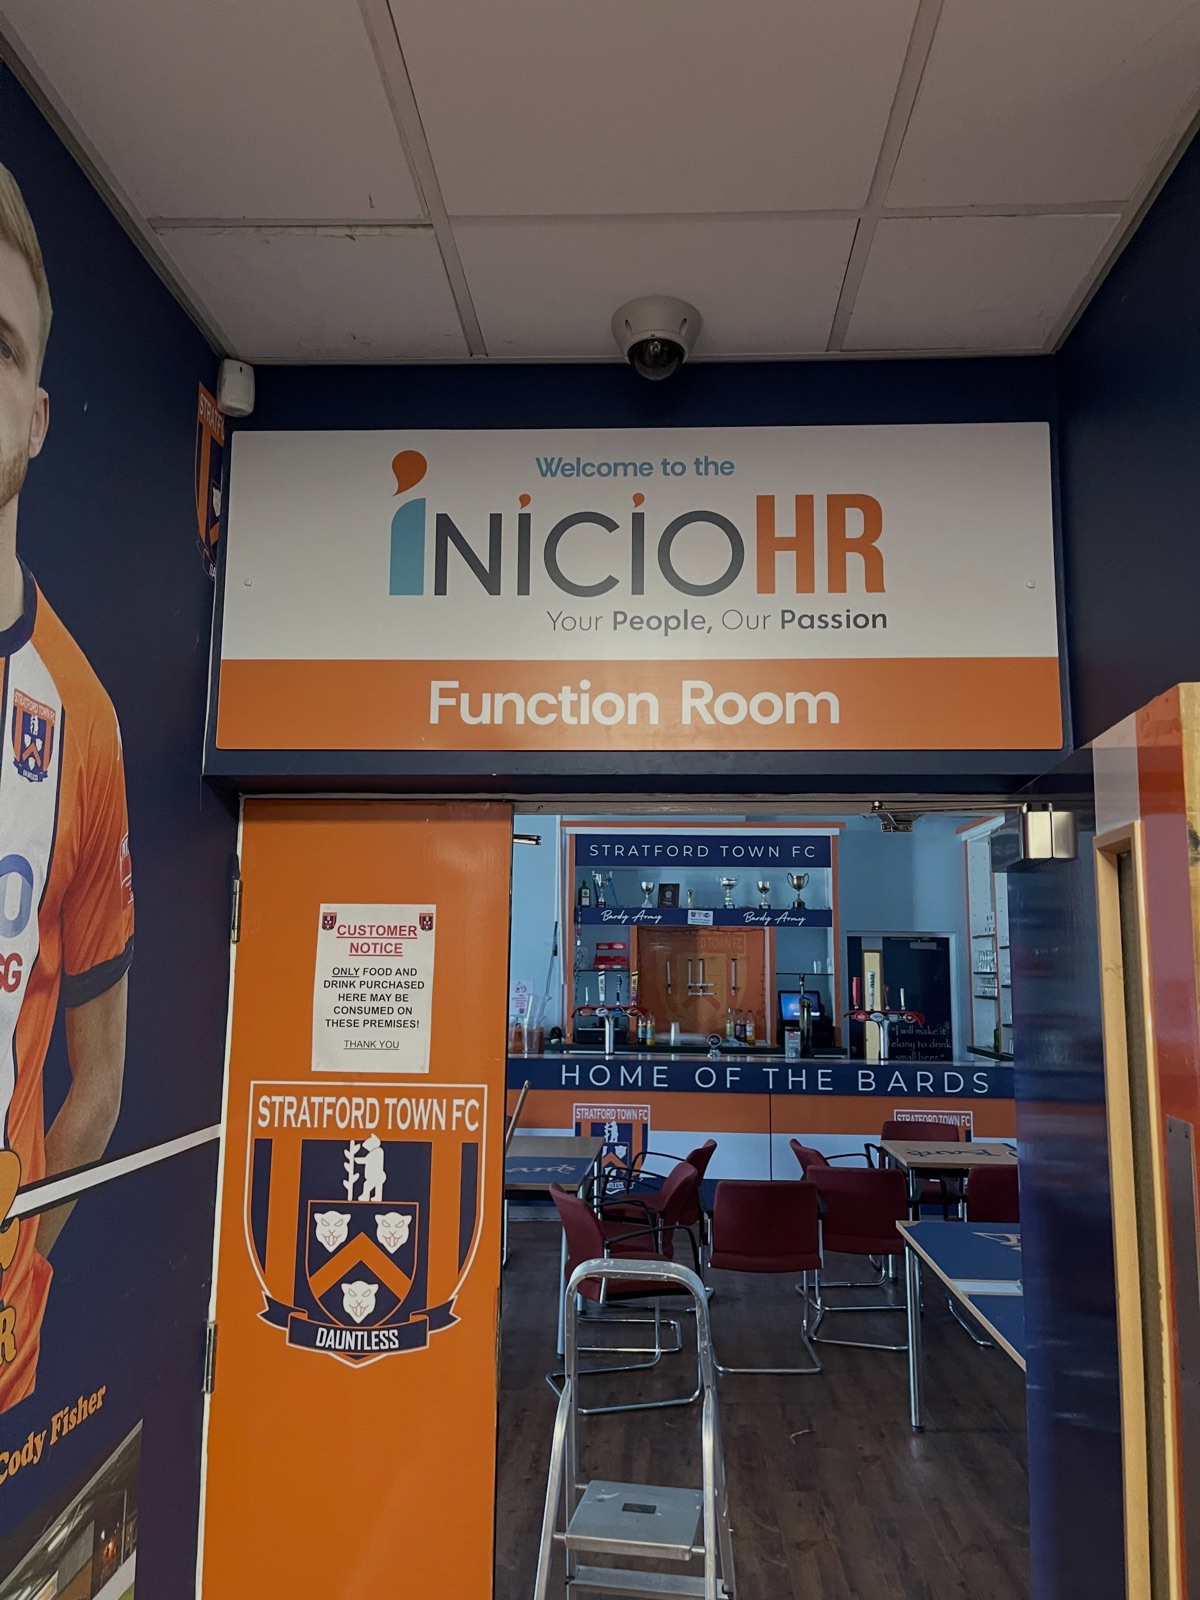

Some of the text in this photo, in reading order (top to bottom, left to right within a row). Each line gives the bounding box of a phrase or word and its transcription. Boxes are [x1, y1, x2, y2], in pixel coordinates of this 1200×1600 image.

[535, 456, 735, 478] Welcome to the
[547, 609, 888, 636] Your People, Our Passion
[428, 678, 841, 726] Function Room
[589, 844, 815, 858] STRATFORD TOWN FC
[632, 910, 663, 923] Army
[774, 911, 806, 925] Army
[337, 925, 417, 937] CUSTOMER
[350, 943, 403, 954] NOTICE
[332, 967, 417, 977] ONLY FOOD AND
[324, 980, 425, 990] DRINK PURCHASED
[338, 993, 409, 1002] HERE MAY BE
[333, 1006, 413, 1015] CONSUMED ON
[325, 1019, 420, 1028] THESE PREMISES!
[900, 1025, 914, 1035] will
[916, 1025, 937, 1035] make
[940, 1027, 947, 1035] it
[344, 1040, 400, 1049] THANK YOU
[929, 1038, 952, 1048] drink
[562, 1065, 989, 1093] HOME OF THE BARDS
[257, 1095, 480, 1132] STRATFORD TOWN FC
[576, 1108, 648, 1120] STRATFORD TOWN FC
[938, 1115, 960, 1126] TOWN
[961, 1116, 971, 1127] FC
[316, 1327, 399, 1351] DAUNTLESS
[50, 1385, 106, 1446] Fisher
